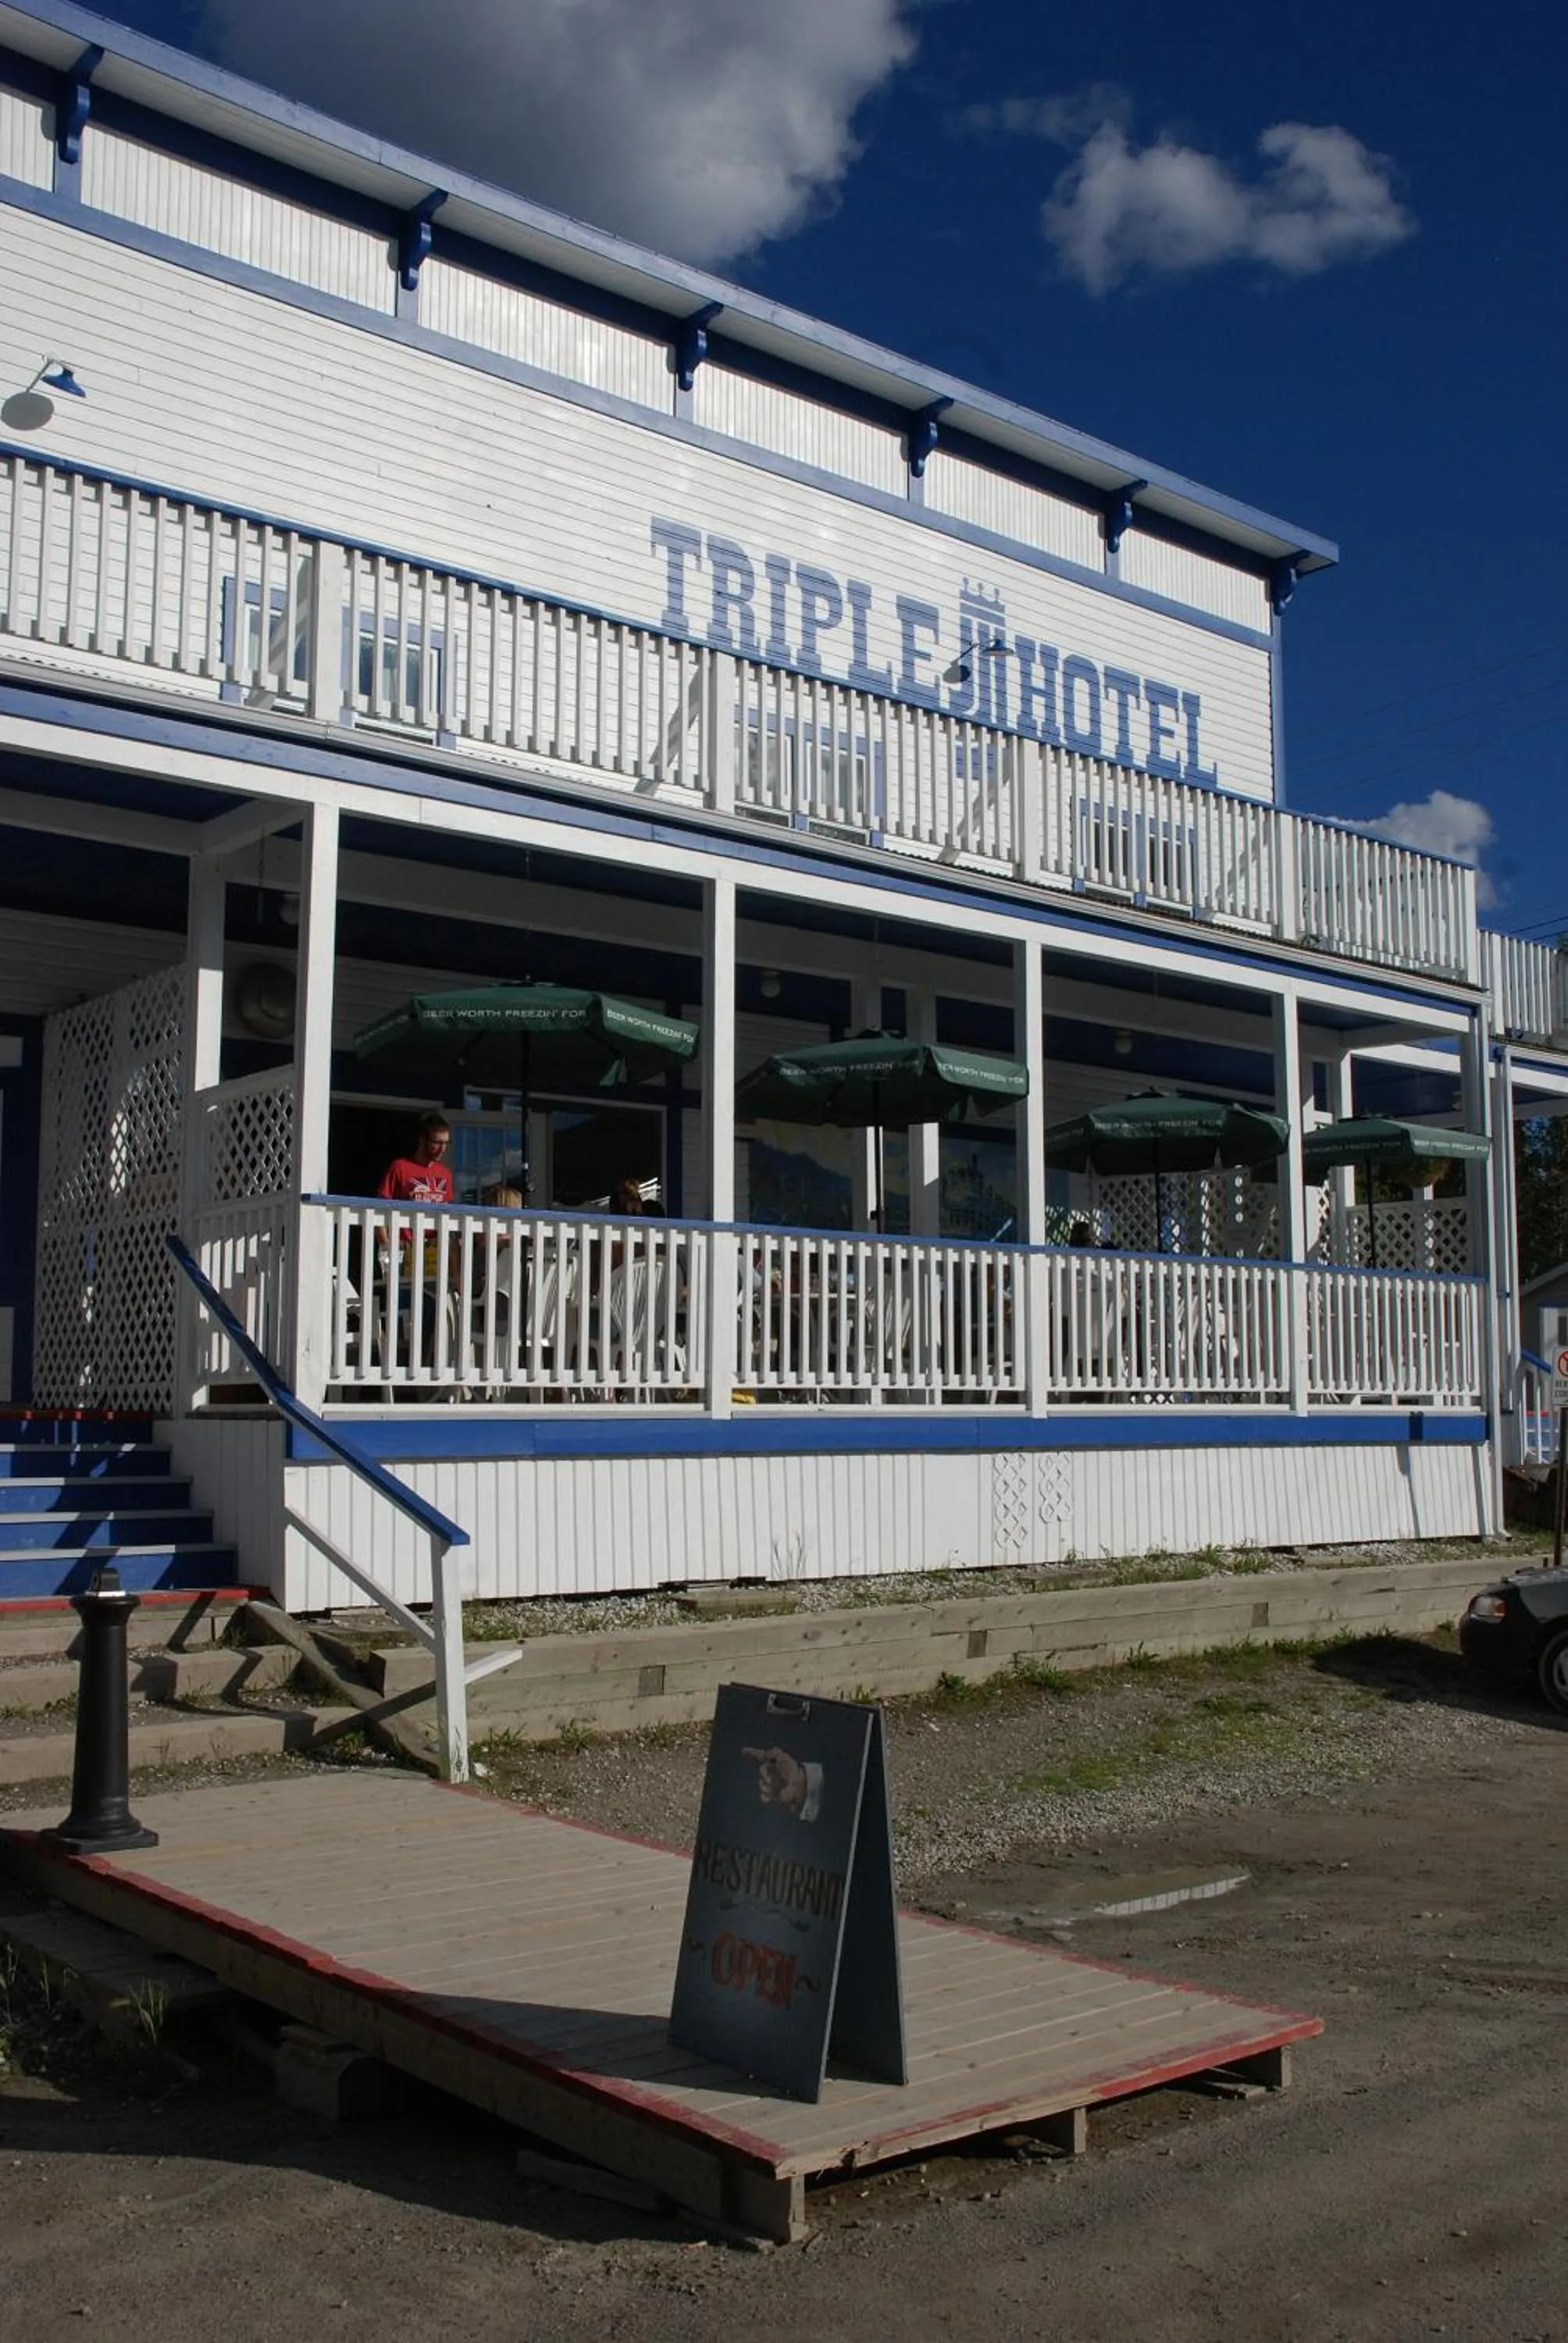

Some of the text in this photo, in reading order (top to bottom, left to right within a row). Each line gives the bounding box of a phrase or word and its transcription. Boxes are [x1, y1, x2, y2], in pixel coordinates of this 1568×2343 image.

[650, 517, 941, 708] TRIPLE
[1014, 634, 1217, 786] HOTEL
[454, 1009, 501, 1018] WORTH
[694, 1839, 844, 1921] RESTAURANT
[711, 1931, 799, 2008] OPEN
